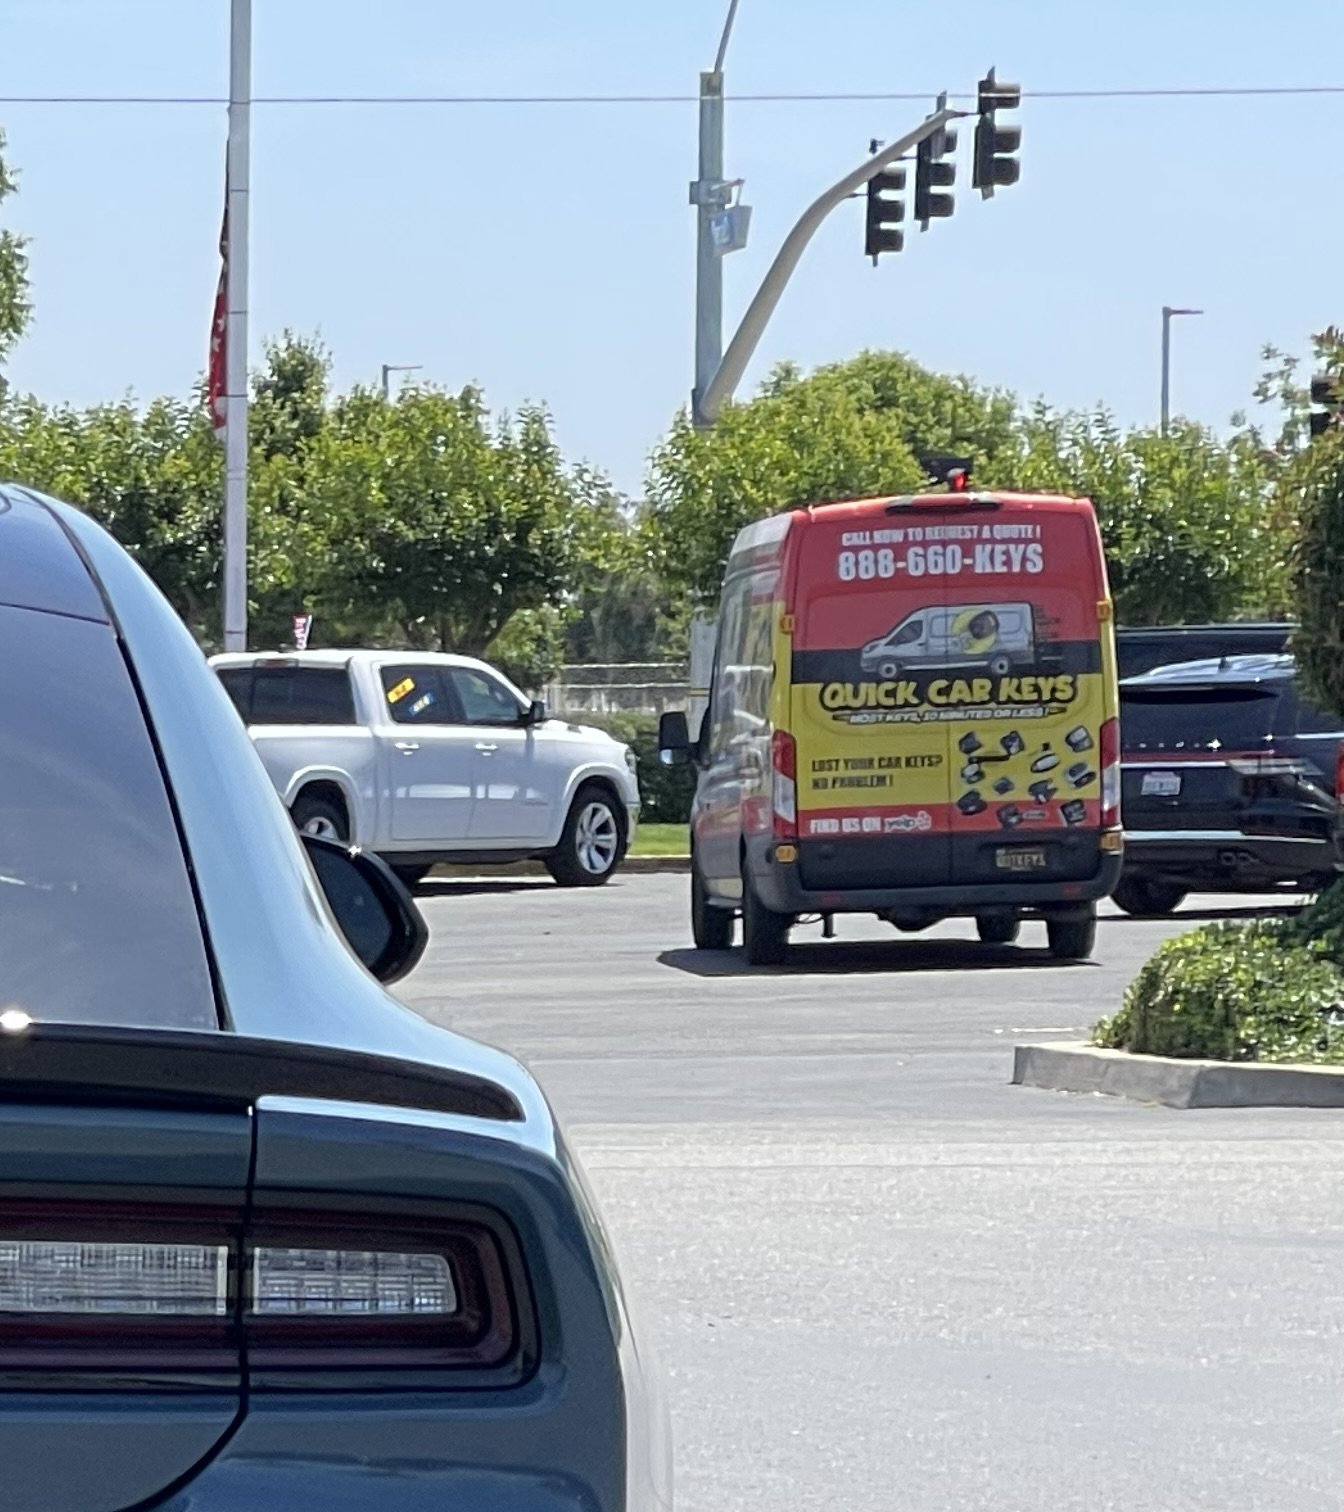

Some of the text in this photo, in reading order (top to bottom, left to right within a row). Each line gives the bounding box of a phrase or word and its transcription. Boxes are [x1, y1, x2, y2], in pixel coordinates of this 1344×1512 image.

[842, 531, 871, 546] CALL
[908, 528, 923, 541] TO
[982, 525, 990, 539] A
[839, 543, 1043, 581] 888-660-KEYS
[823, 675, 1073, 709] QUICK CAR KEYS
[813, 758, 839, 772] LOST
[878, 756, 902, 769] CAR
[905, 754, 943, 768] KEYS?
